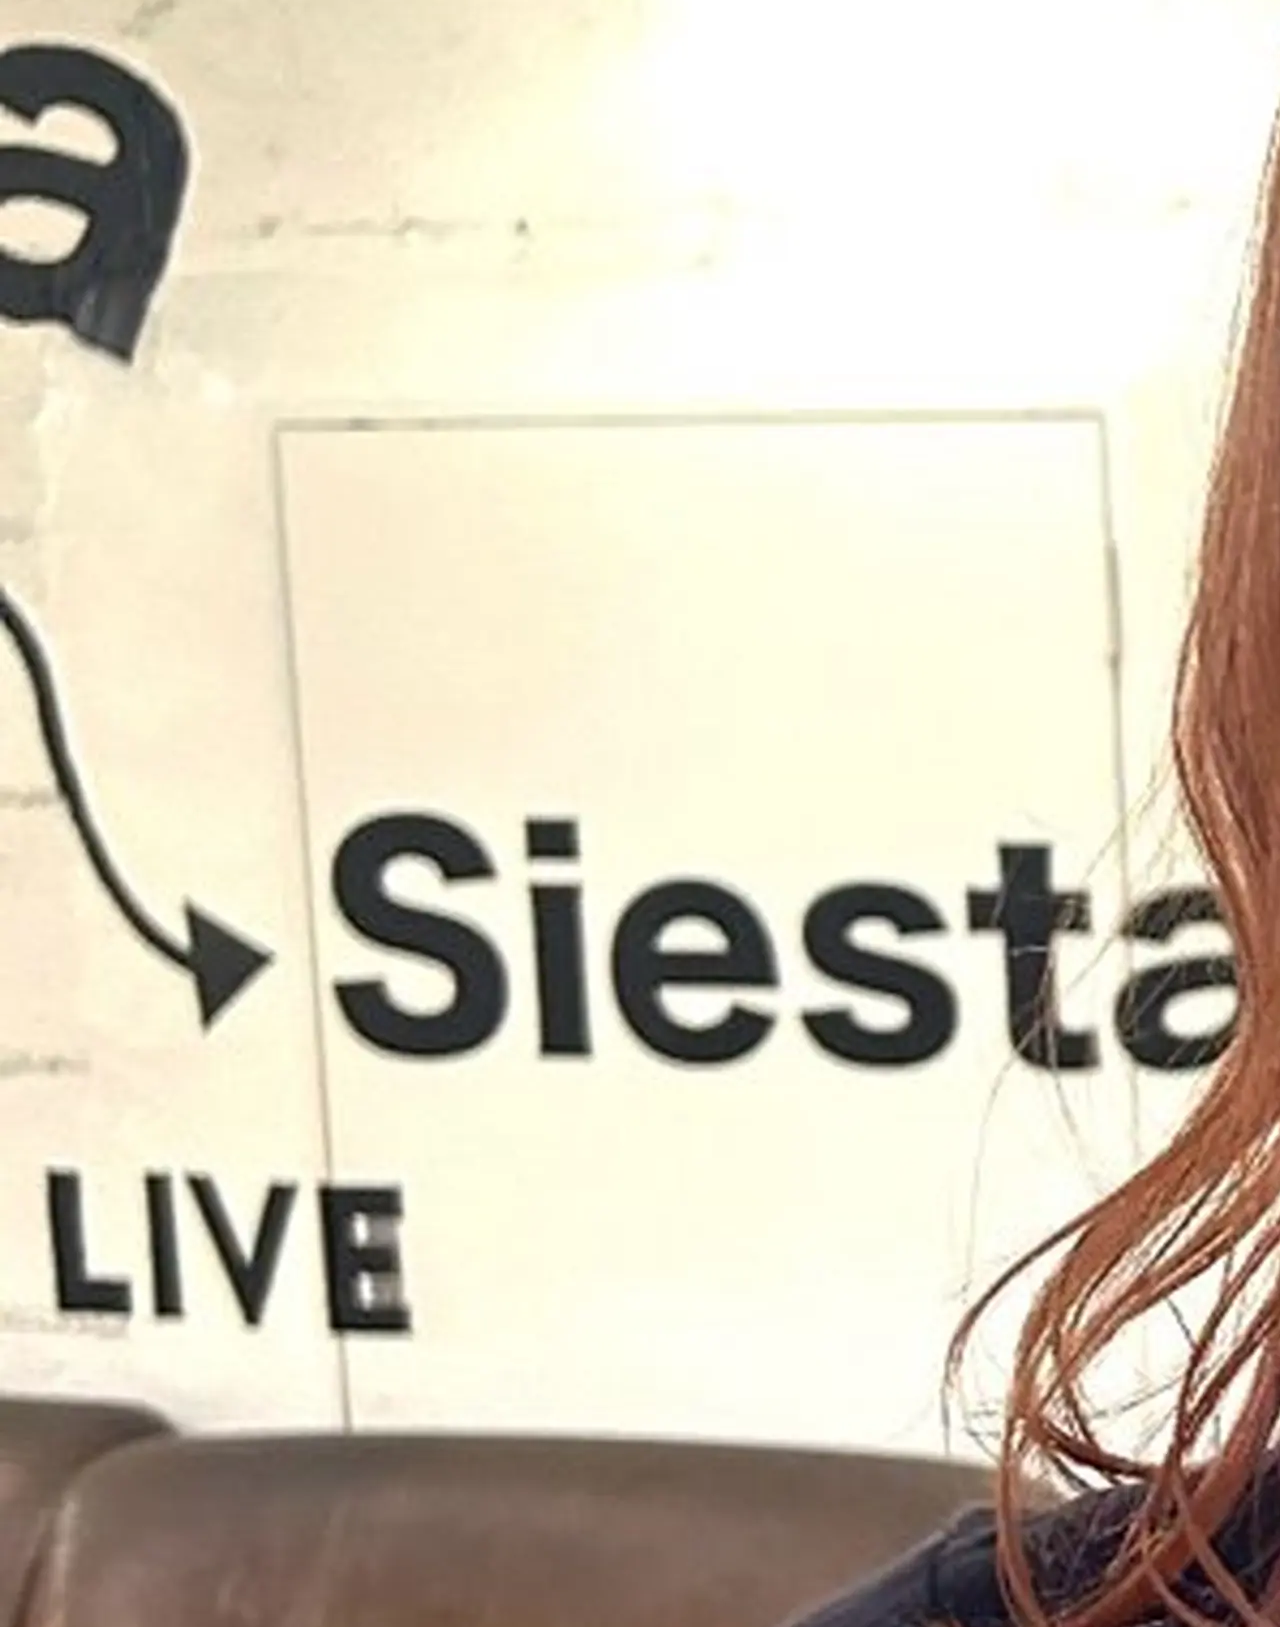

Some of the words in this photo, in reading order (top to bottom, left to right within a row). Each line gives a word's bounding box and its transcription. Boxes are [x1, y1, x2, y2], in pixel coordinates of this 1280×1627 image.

[0, 45, 189, 363] a
[331, 811, 1241, 1071] Siesta
[46, 1168, 412, 1334] LIVE
